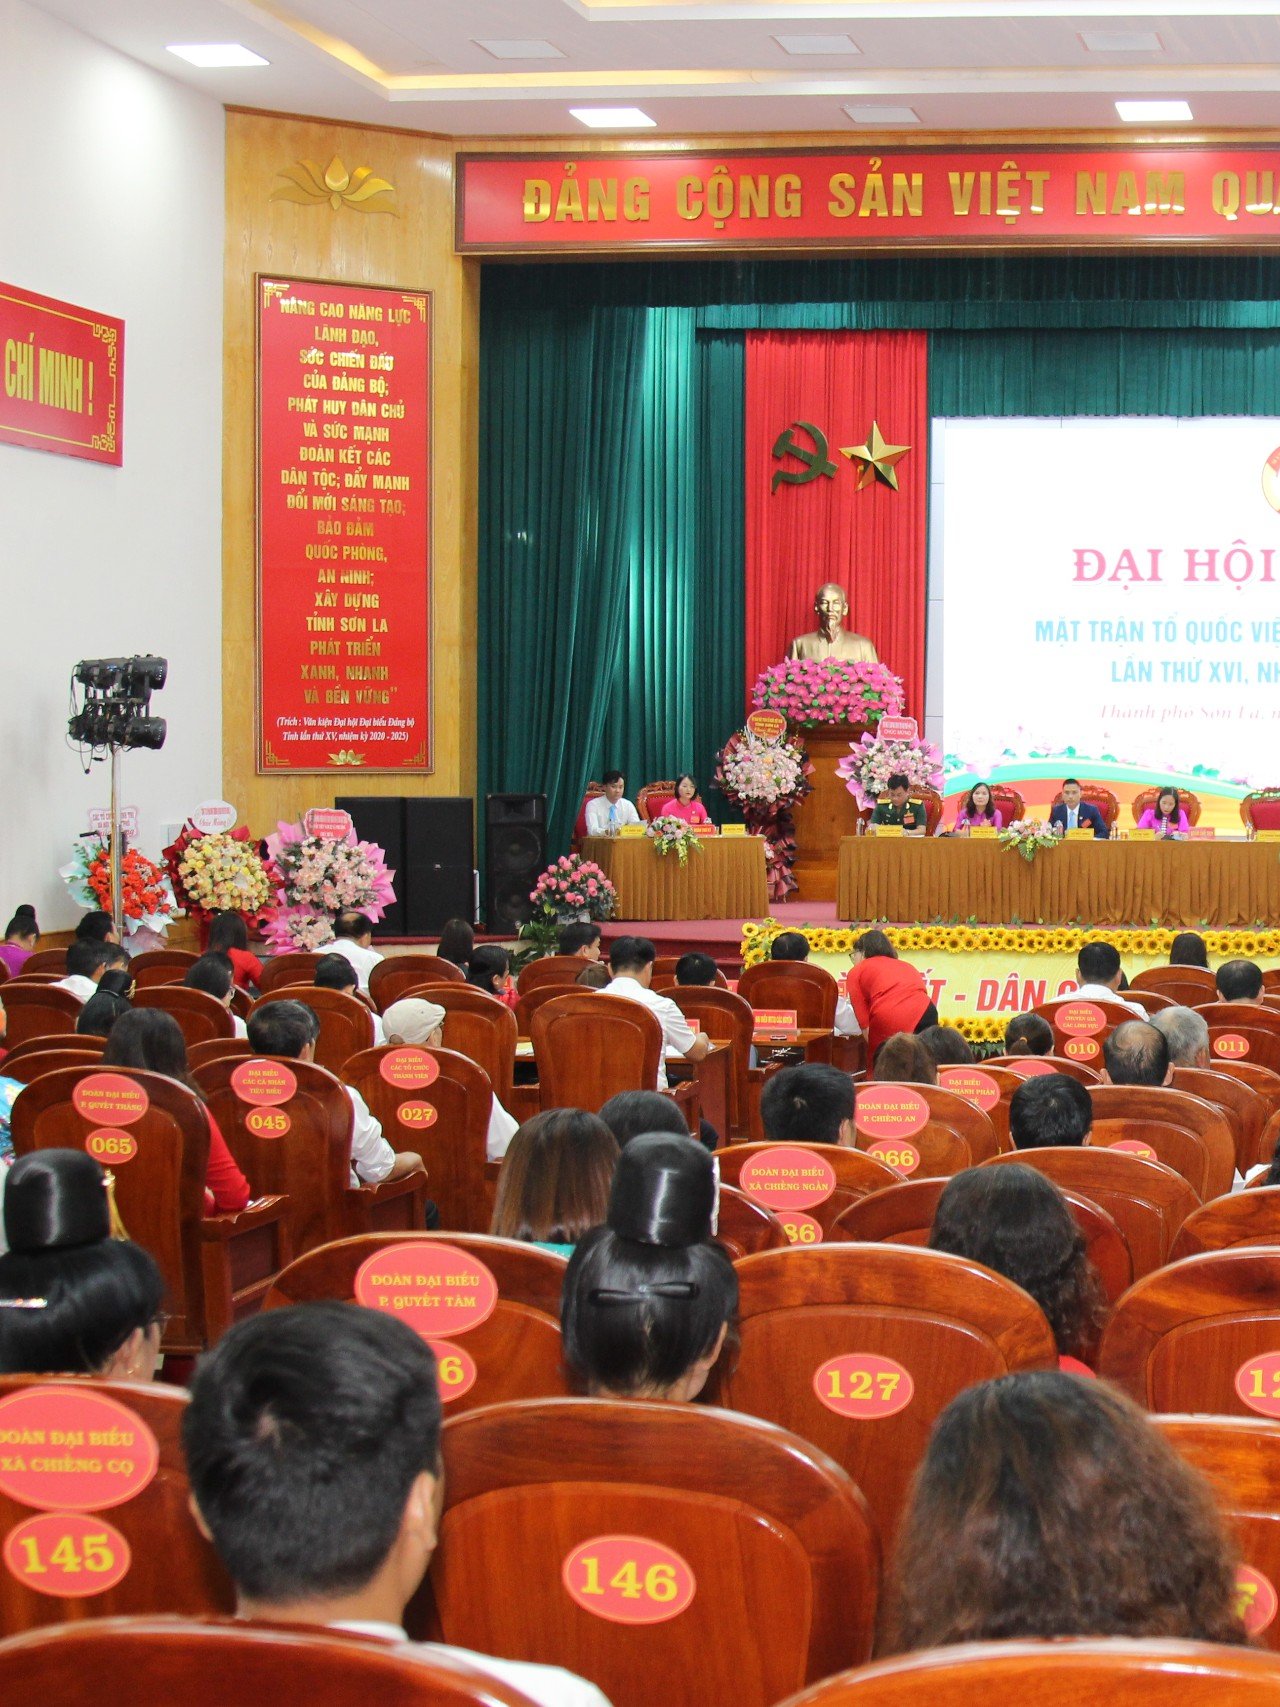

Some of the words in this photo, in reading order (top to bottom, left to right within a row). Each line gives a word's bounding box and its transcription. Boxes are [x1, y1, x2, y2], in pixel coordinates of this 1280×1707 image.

[523, 162, 650, 224] ĐẢNG
[676, 164, 802, 229] CỘNG
[828, 156, 923, 219] SẢN
[947, 161, 1050, 225] VIỆT
[1075, 171, 1185, 217] NAM
[319, 302, 344, 318] CAO
[349, 303, 383, 321] NĂNG
[388, 307, 411, 326] LỰC
[314, 324, 347, 343] LÃNH
[351, 329, 379, 348] ĐẠO,
[299, 346, 325, 365] SỨC
[330, 349, 365, 369] CHIẾN
[369, 351, 394, 371] ĐẤU
[4, 332, 35, 401] CHÍ
[39, 347, 83, 414] MINH
[88, 361, 94, 416] !
[303, 369, 327, 389] CỦA
[332, 371, 365, 392] ĐẢNG
[369, 376, 389, 397] BỘ;
[287, 395, 319, 413] PHÁT
[323, 399, 347, 415] HUY
[351, 399, 377, 417] DÂN
[381, 399, 405, 419] CHỦ
[303, 418, 318, 438] VÀ
[323, 420, 348, 440] SỨC
[353, 425, 390, 444] MẠNH
[299, 444, 334, 463] ĐOÀN
[338, 444, 362, 465] KẾT
[366, 447, 391, 466] CÁC
[280, 467, 307, 486] DÂN
[312, 468, 341, 490] TỘC;
[344, 466, 368, 489] ĐẨY
[372, 474, 410, 494] MẠNH
[286, 487, 307, 510] ĐỔI
[312, 492, 337, 512] MỚI
[341, 494, 375, 513] SÁNG
[1072, 548, 1164, 591] ĐẠI
[1183, 538, 1277, 591] HỘI
[1034, 616, 1080, 648] MẶT
[1089, 616, 1145, 648] TRẬN
[1152, 610, 1178, 644] TỔ
[1185, 612, 1243, 645] QUỐC
[1110, 652, 1153, 684] LẦN
[1160, 657, 1202, 684] THỨ
[1208, 660, 1249, 686] XVI,
[976, 972, 1046, 1012] DÂN
[1068, 1043, 1096, 1055] 010
[1218, 1041, 1246, 1053] 011
[401, 1107, 433, 1121] 027
[858, 1101, 881, 1111] ĐOÀN
[883, 1102, 898, 1112] ĐẠI
[250, 1115, 287, 1130] 045
[92, 1137, 132, 1155] 065
[751, 1166, 779, 1177] ĐOÀN
[781, 1168, 799, 1179] ĐẠI
[801, 1165, 825, 1177] BIỂU
[783, 1223, 816, 1243] 86
[371, 1273, 412, 1286] ĐOÀN
[416, 1274, 442, 1288] ĐẠI
[446, 1271, 480, 1287] BIỂU
[393, 1292, 440, 1310] QUYẾT
[444, 1295, 476, 1308] TÂM
[826, 1370, 901, 1401] 127
[50, 1430, 84, 1449] ĐẠI
[89, 1426, 135, 1446] BIỂU
[107, 1458, 135, 1477] CỌ
[20, 1533, 115, 1574] 145
[580, 1555, 679, 1602] 146
